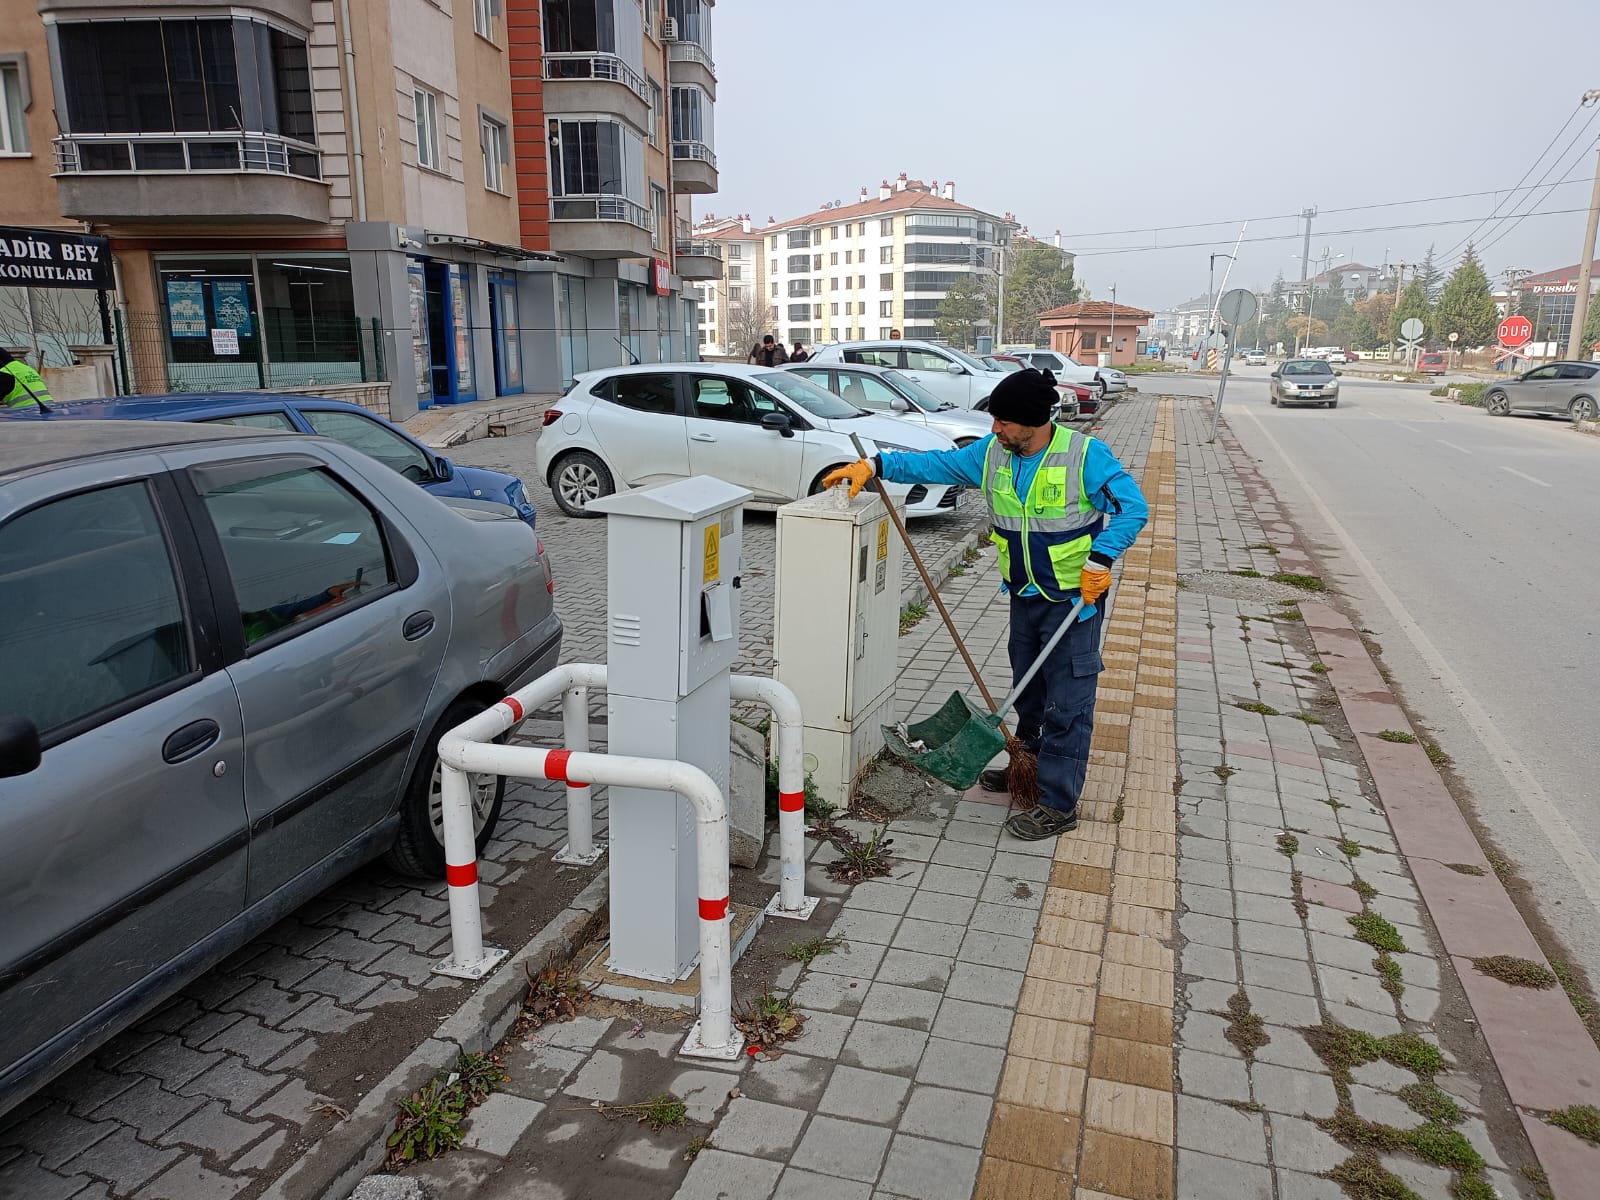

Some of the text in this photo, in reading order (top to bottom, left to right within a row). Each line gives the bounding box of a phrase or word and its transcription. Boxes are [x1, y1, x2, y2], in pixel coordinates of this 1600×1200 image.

[0, 236, 98, 262] ADİR BEY
[0, 263, 93, 280] KONUTLARI
[1500, 325, 1529, 337] DUR
